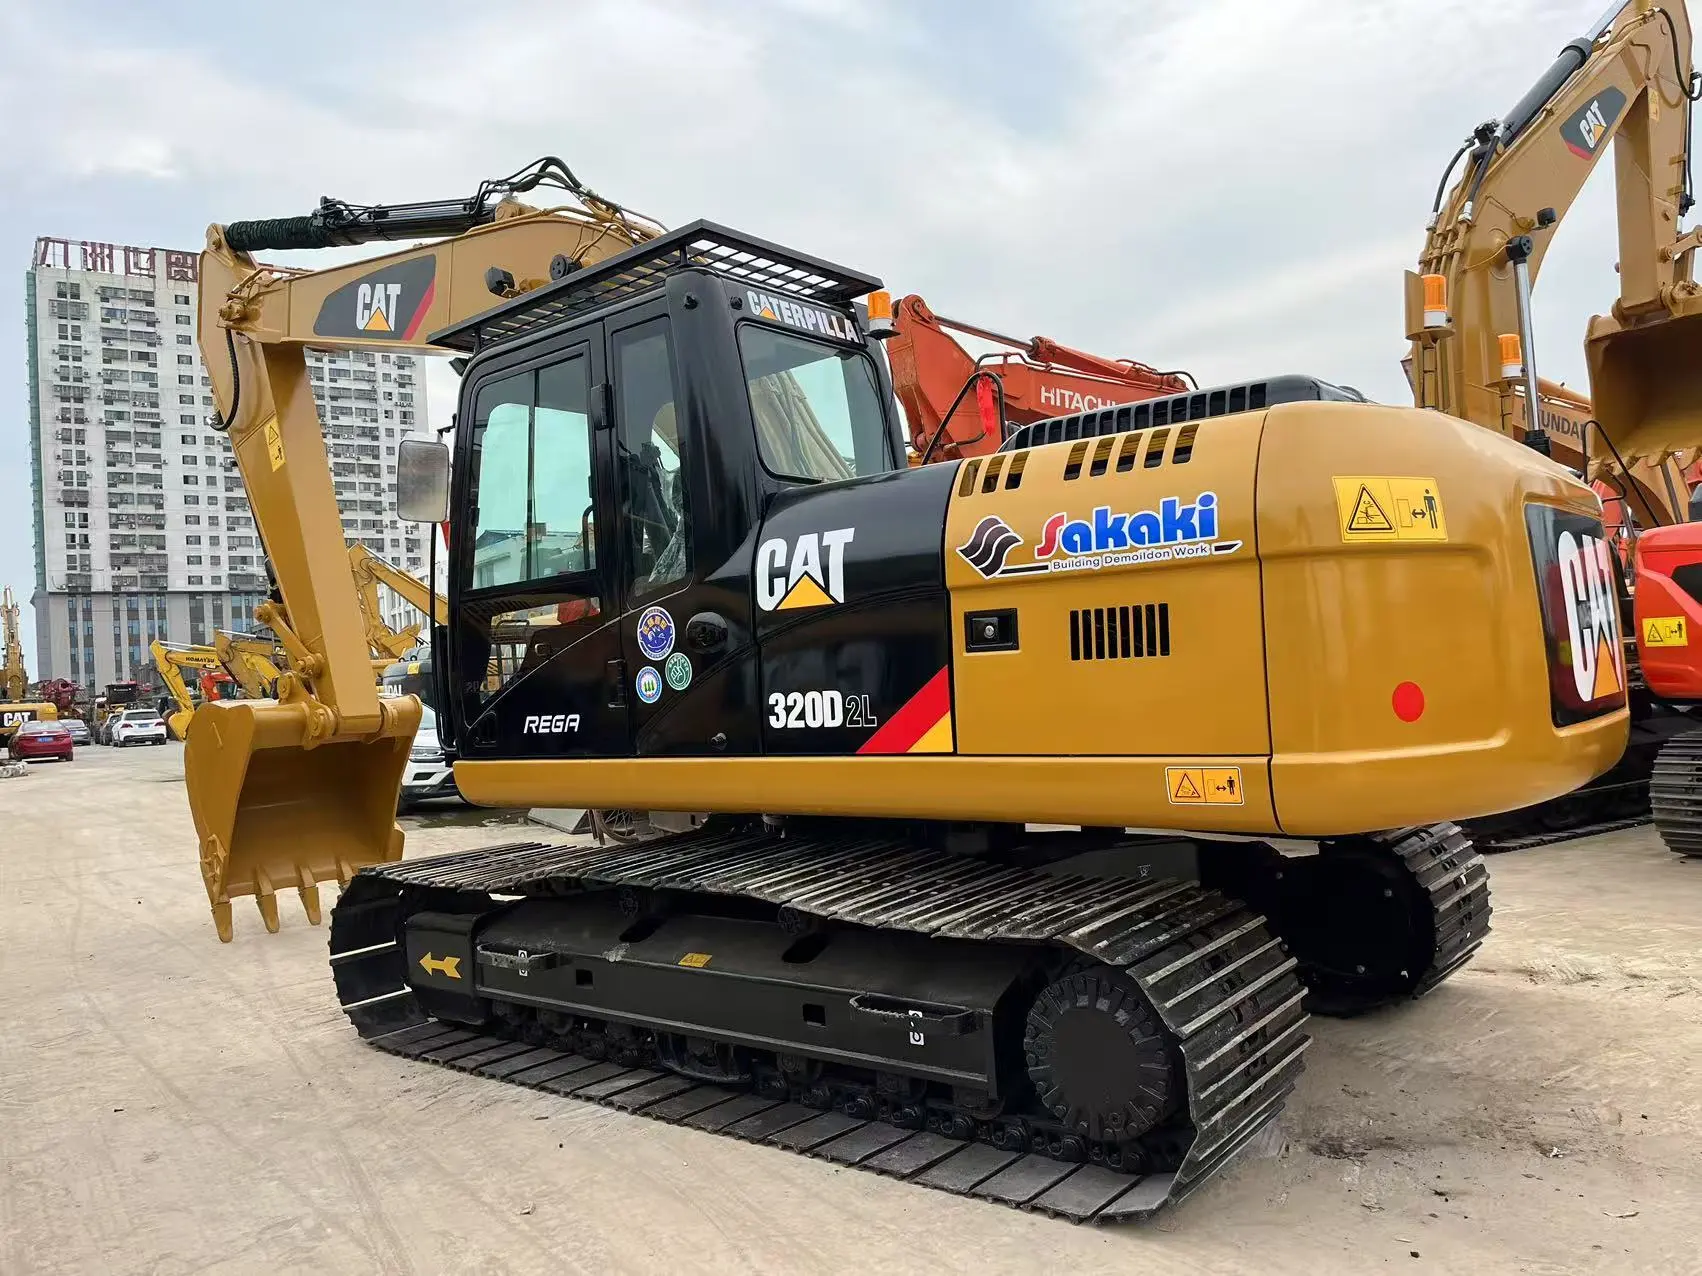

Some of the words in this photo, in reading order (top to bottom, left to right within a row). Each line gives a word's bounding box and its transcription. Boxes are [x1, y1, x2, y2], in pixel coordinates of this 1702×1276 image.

[1580, 100, 1607, 148] CAT
[356, 283, 401, 331] CAT
[1037, 494, 1215, 557] Sakaki
[757, 527, 855, 611] CAT
[1053, 558, 1100, 570] Building
[1175, 545, 1208, 556] Work
[1558, 530, 1624, 701] CAT
[3, 712, 31, 727] CAT
[523, 714, 580, 734] REGA
